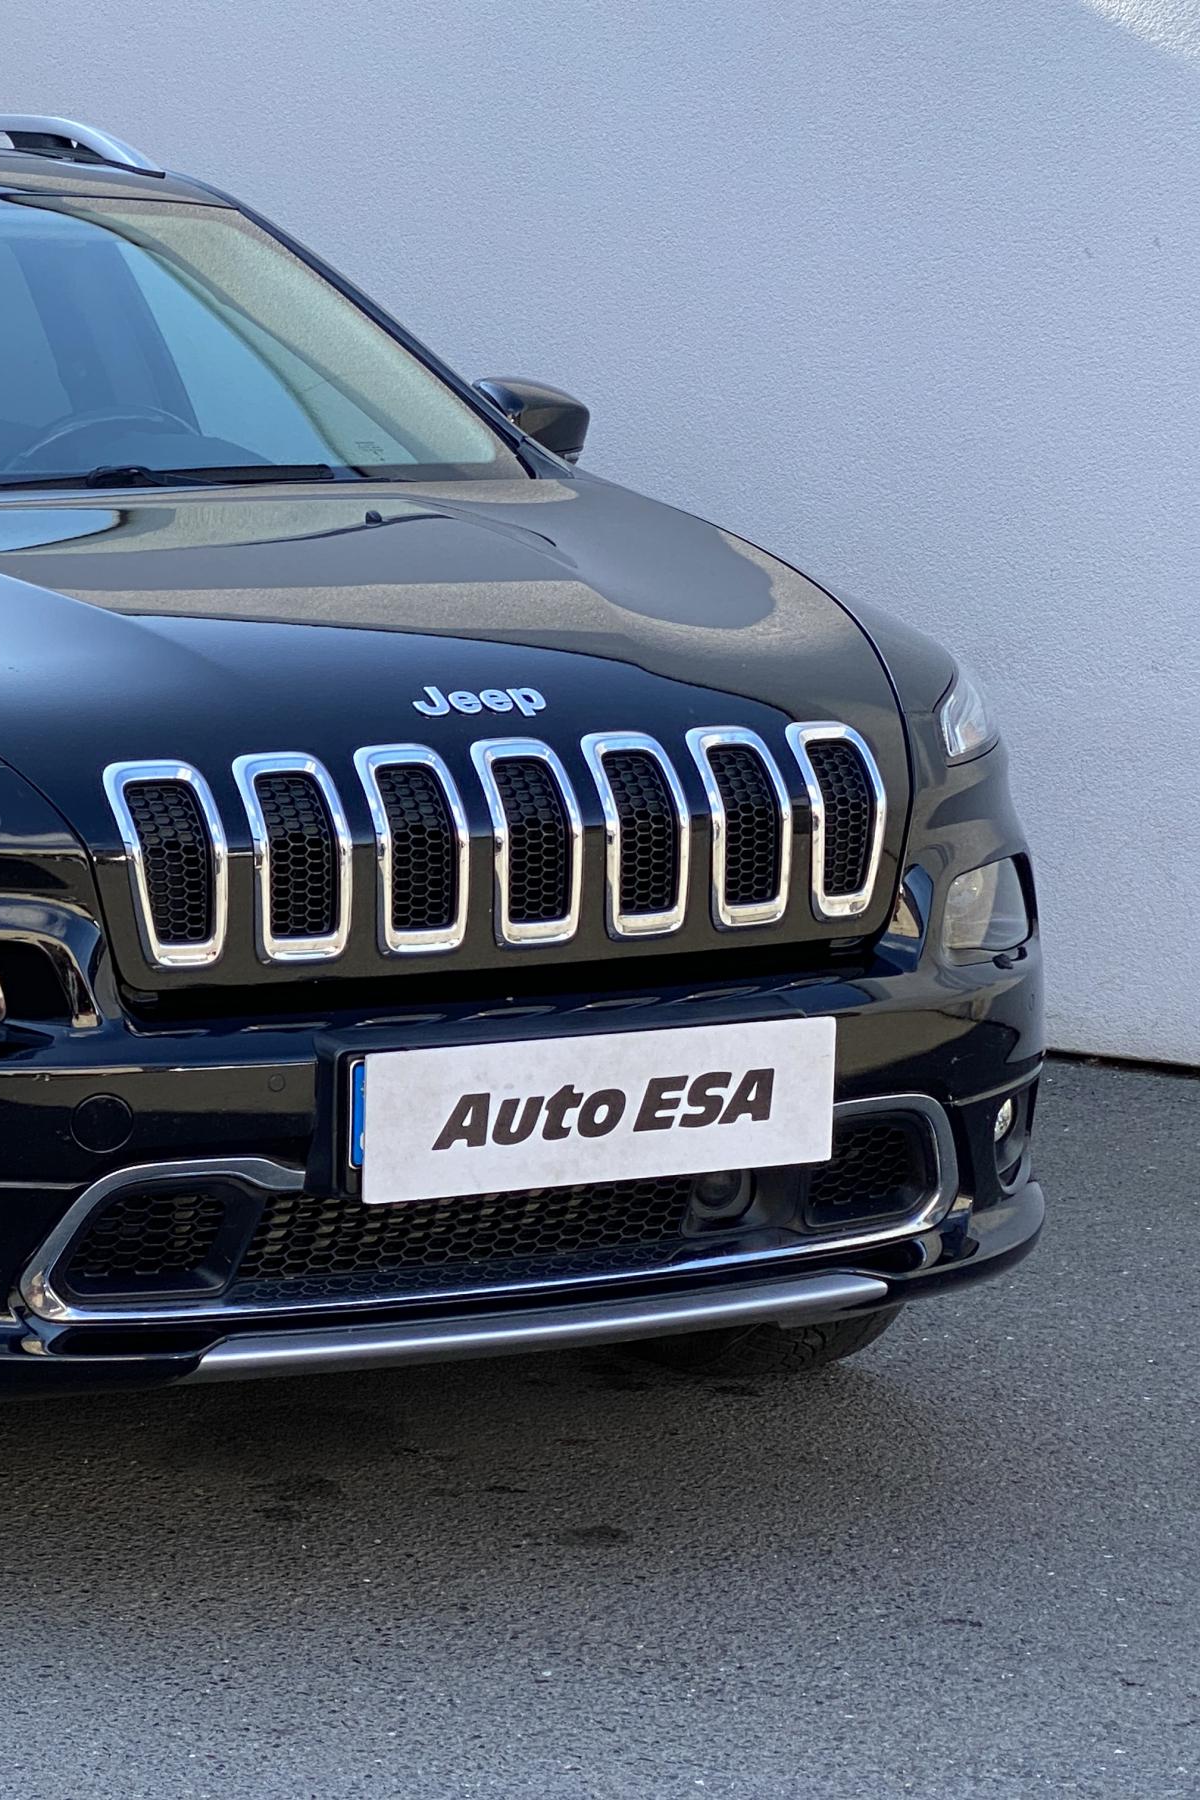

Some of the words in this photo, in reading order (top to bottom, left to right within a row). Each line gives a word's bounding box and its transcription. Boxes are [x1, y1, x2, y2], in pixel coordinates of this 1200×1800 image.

[412, 686, 547, 717] Jeep
[431, 1084, 627, 1150] Auto
[633, 1068, 775, 1132] ESA
